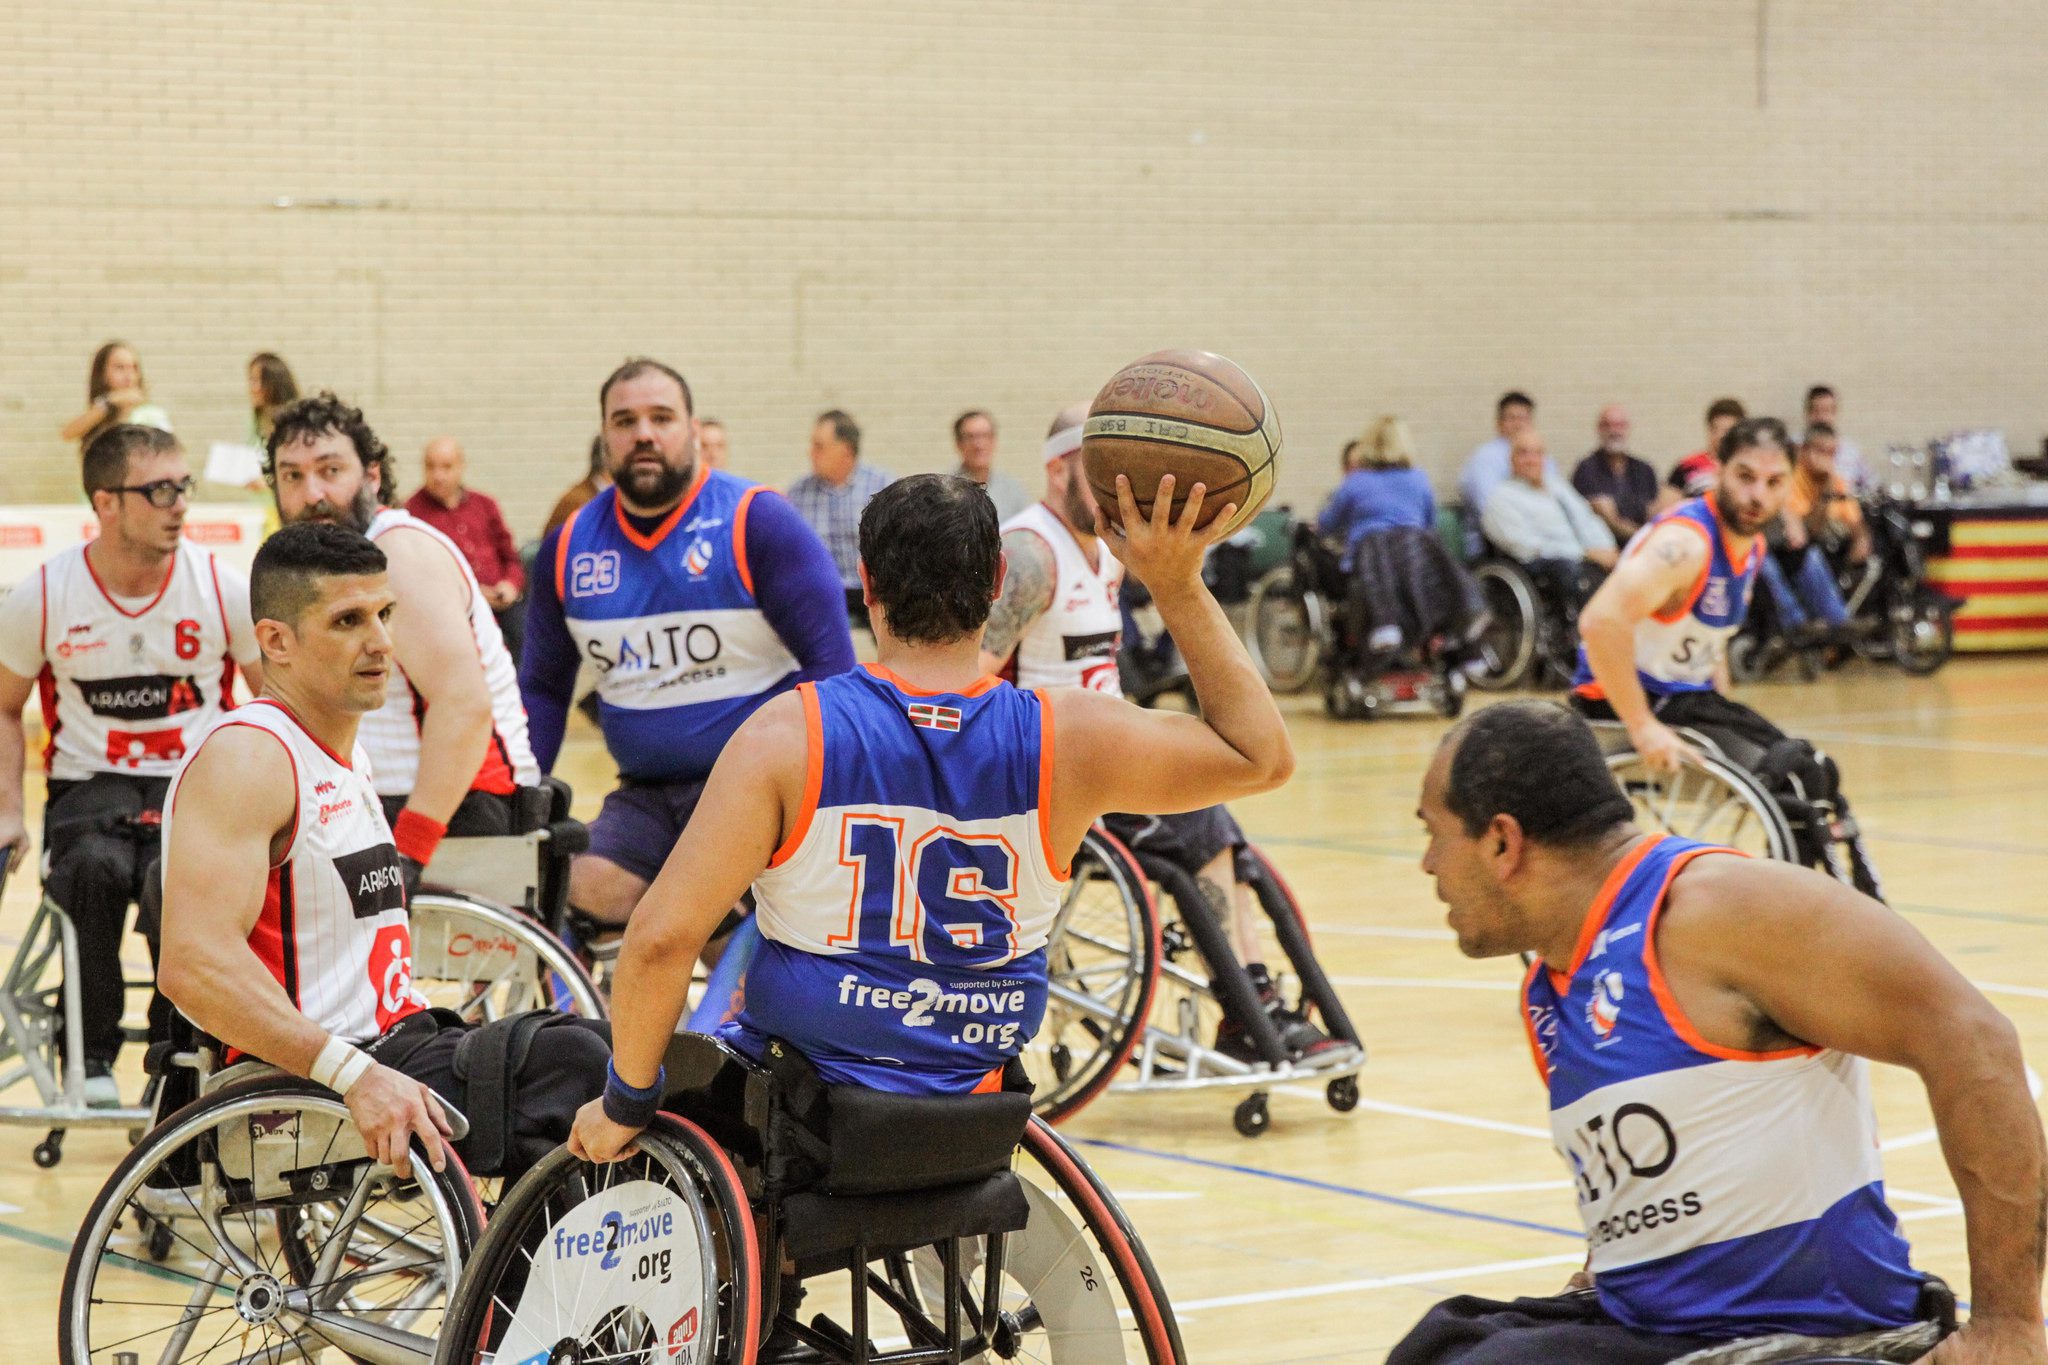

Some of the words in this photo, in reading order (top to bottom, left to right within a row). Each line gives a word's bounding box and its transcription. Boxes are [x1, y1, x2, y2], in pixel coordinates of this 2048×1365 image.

[571, 550, 621, 598] 23
[175, 619, 201, 660] 6
[587, 624, 721, 674] SALTO
[827, 813, 1021, 966] 16
[838, 974, 1025, 1028] free2move
[950, 980, 990, 990] supported
[991, 980, 1001, 989] by
[951, 1022, 1020, 1050] .org
[554, 1210, 673, 1271] free2move
[632, 1248, 672, 1284] .org
[1079, 1265, 1099, 1292] 26
